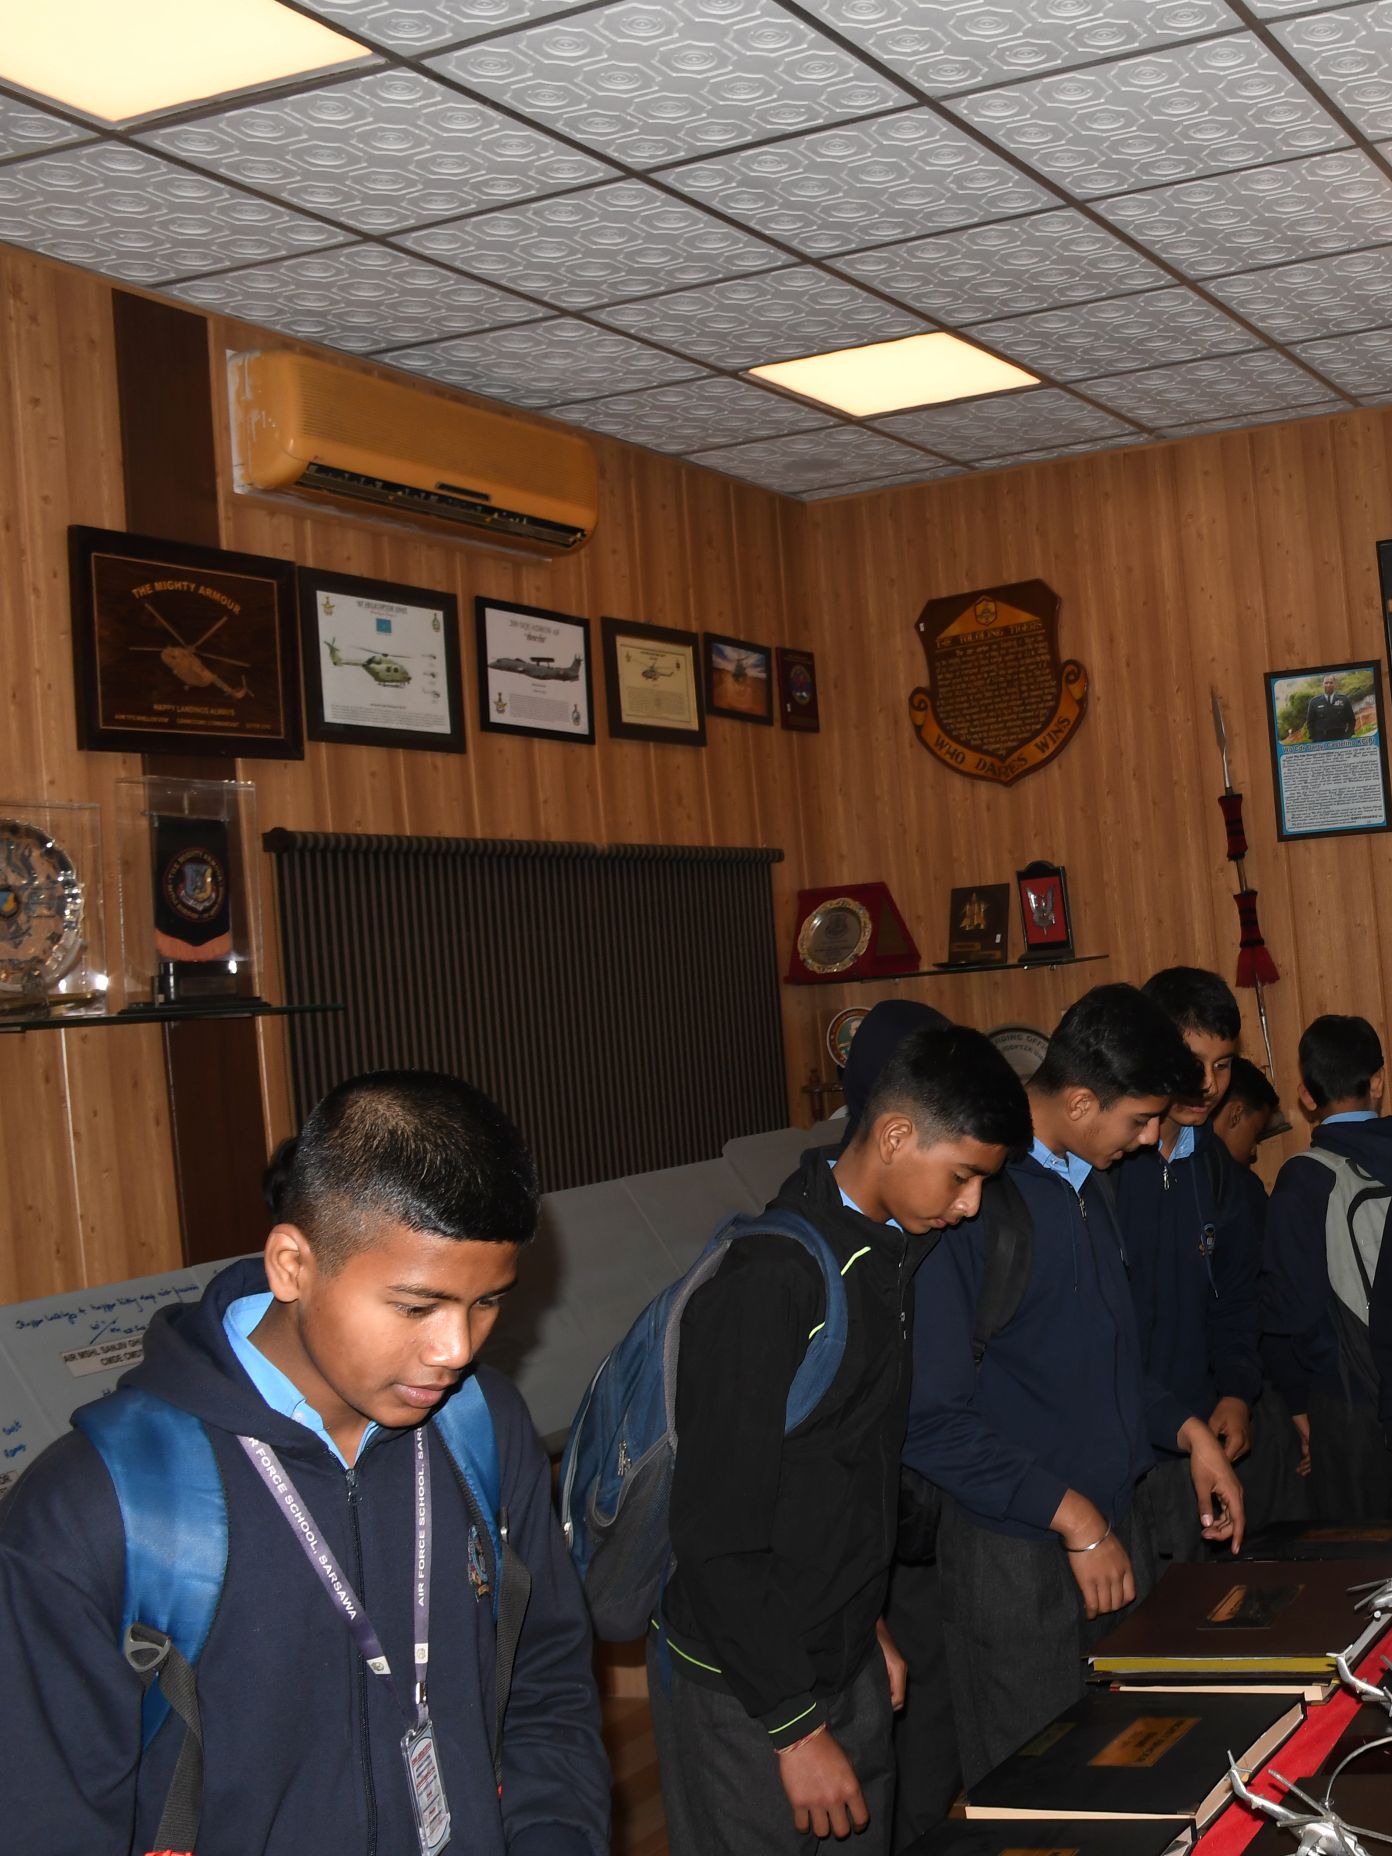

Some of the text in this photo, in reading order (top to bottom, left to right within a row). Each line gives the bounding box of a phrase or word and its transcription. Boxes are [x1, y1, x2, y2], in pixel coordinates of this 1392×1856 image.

[132, 580, 241, 616] THE MIGHTY ARMOUR
[934, 715, 1071, 778] WHO DARES WINS
[63, 1353, 78, 1363] AIR
[78, 1348, 100, 1360] MSHL
[418, 1464, 426, 1526] SCHOOL,
[256, 1447, 358, 1621] FORCE SCHOOL, SARSAWA
[418, 1530, 426, 1579] FORCE
[417, 1583, 425, 1607] AIR
